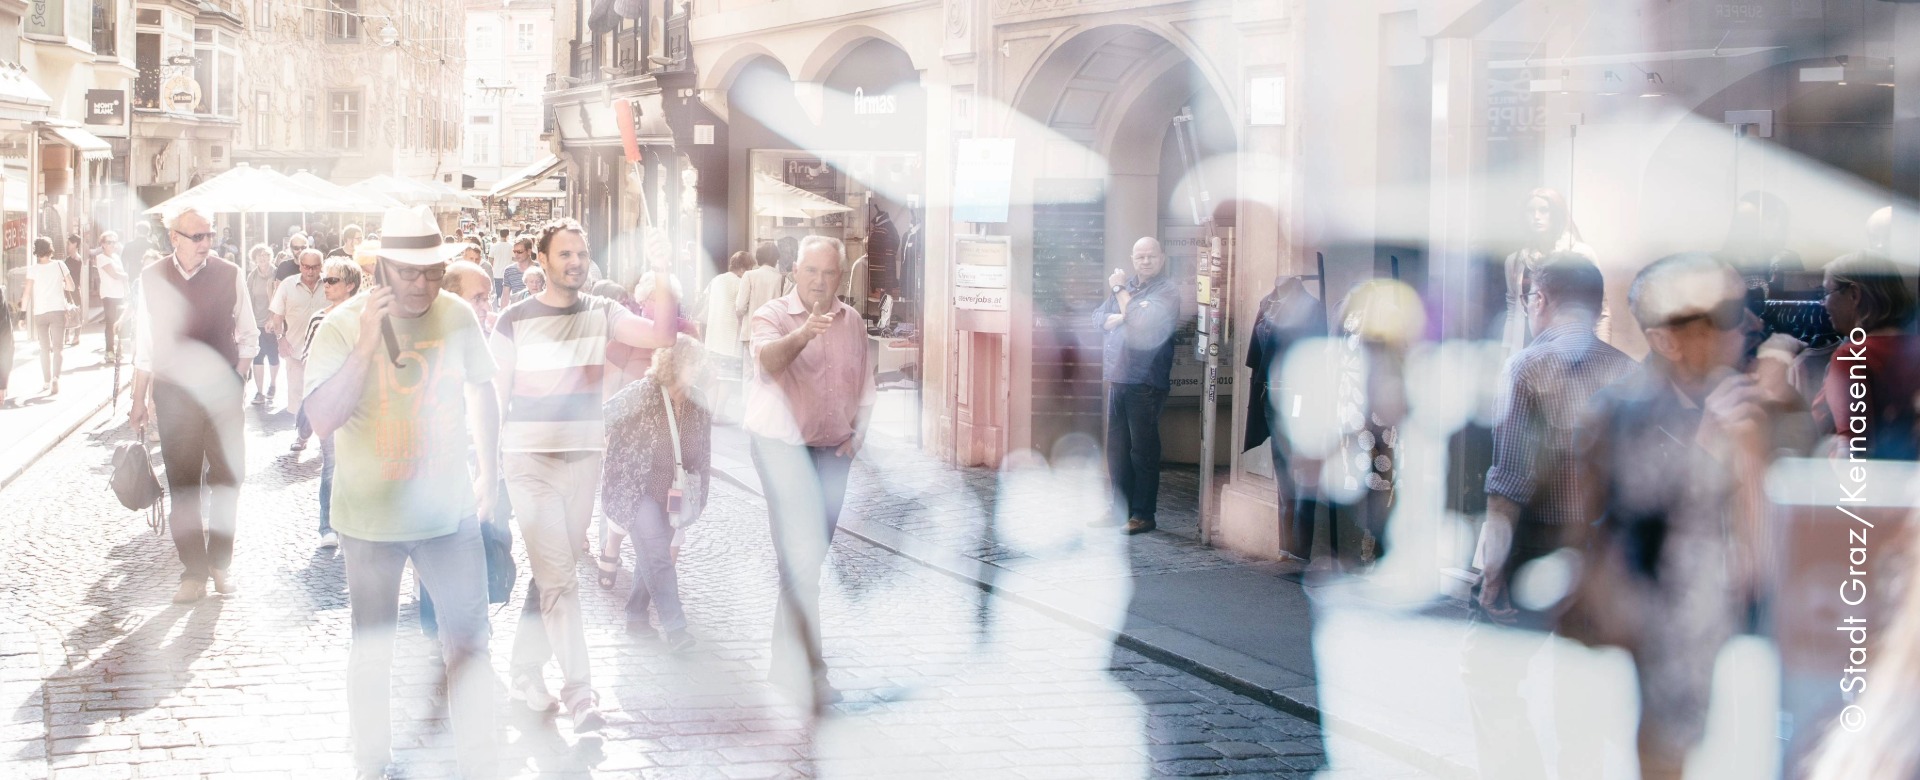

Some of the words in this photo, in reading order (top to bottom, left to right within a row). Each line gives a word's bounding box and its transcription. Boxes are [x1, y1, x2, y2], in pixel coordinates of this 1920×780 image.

[31, 0, 45, 27] Sc
[854, 86, 896, 114] Armas
[1168, 378, 1198, 387] orgasse
[1217, 377, 1233, 385] 010
